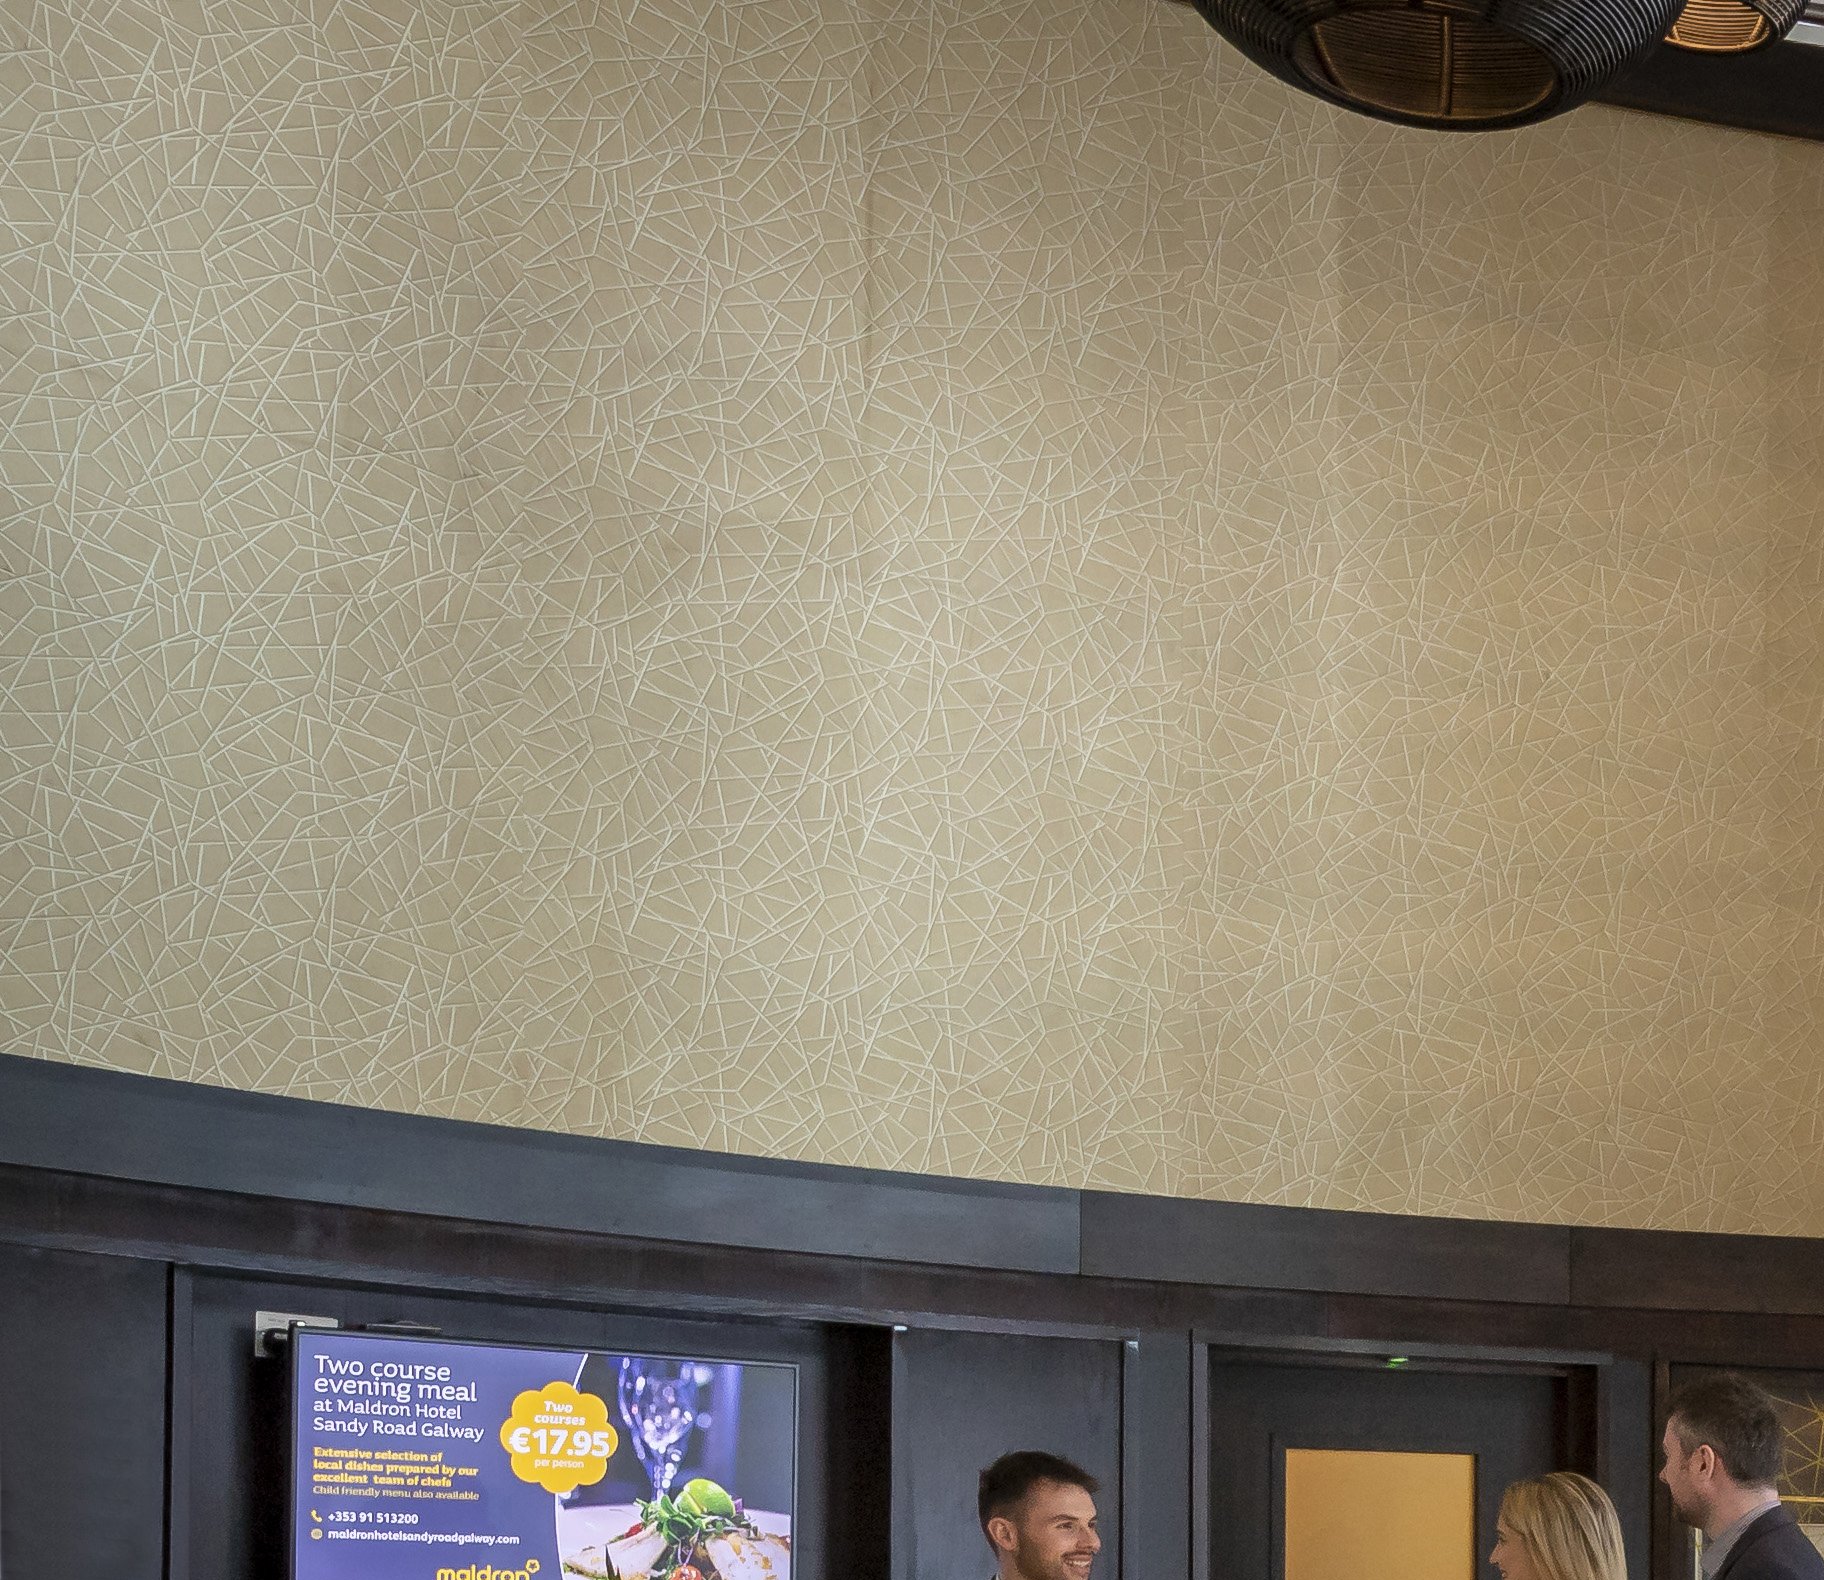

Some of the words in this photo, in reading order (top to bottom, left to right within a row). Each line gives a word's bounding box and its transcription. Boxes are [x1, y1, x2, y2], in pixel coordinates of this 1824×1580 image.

[313, 1354, 364, 1376] Two
[370, 1362, 451, 1382] course
[314, 1377, 412, 1403] evening
[417, 1381, 478, 1402] meal
[313, 1399, 333, 1413] at
[337, 1399, 412, 1417] Maldron
[415, 1403, 462, 1420] Hotel
[543, 1400, 574, 1414] Two
[533, 1414, 586, 1426] courses
[313, 1417, 369, 1436] Sandy
[372, 1420, 417, 1437] Road
[421, 1422, 485, 1443] Galway
[508, 1426, 610, 1457] €17.95
[313, 1447, 373, 1460] Extensive
[374, 1450, 428, 1462] selection
[430, 1452, 444, 1463] of
[313, 1459, 343, 1470] local
[345, 1460, 384, 1472] dishes
[386, 1463, 440, 1476] prepared
[441, 1465, 457, 1477] by
[458, 1468, 479, 1476] our
[534, 1458, 550, 1468] per
[552, 1459, 585, 1469] person
[312, 1472, 369, 1484] excellent
[373, 1475, 405, 1486] team
[406, 1476, 420, 1487] of
[420, 1476, 452, 1488] chefs
[312, 1485, 340, 1496] Child
[341, 1486, 380, 1499] friendly
[382, 1489, 411, 1498] menu
[412, 1489, 434, 1499] also
[435, 1490, 480, 1501] available
[327, 1510, 357, 1522] +353
[359, 1511, 374, 1523] 91
[376, 1512, 419, 1525] 513200
[327, 1529, 521, 1546] maldronhotelsandyroadgalway.com
